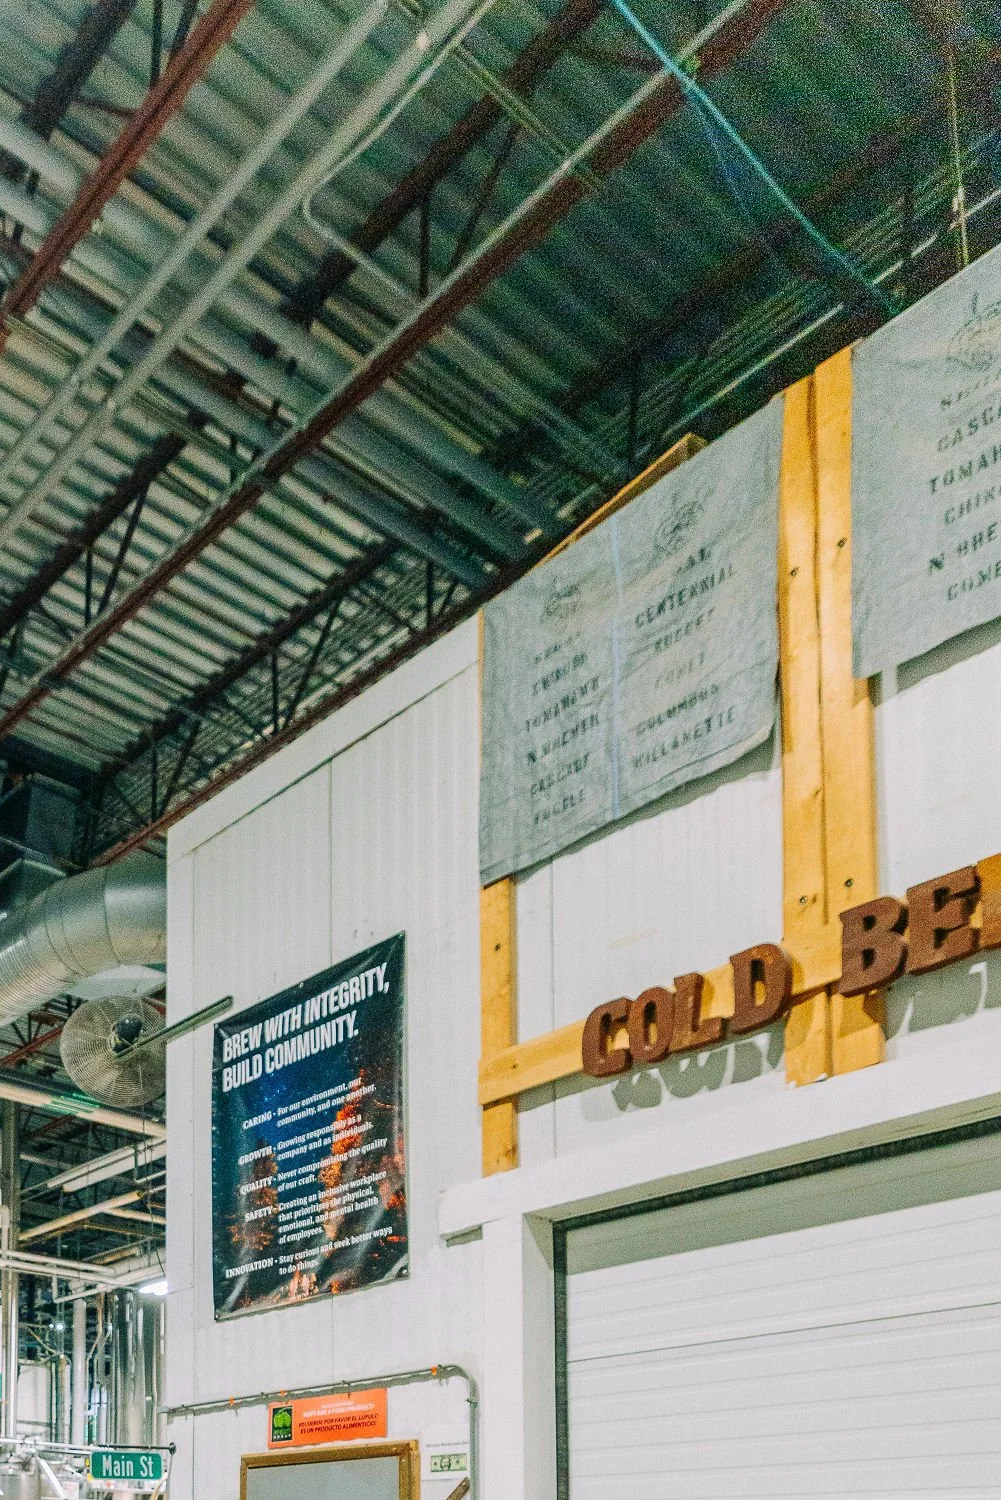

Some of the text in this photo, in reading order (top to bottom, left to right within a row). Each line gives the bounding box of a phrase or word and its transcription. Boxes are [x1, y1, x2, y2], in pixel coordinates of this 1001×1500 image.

[635, 563, 736, 628] CENTENNIAL
[223, 961, 390, 1063] BREW WITH INTEGRITY,
[582, 943, 792, 1078] COLD
[222, 1010, 359, 1093] BUILD COMMUNITY.
[242, 1110, 272, 1130] CARING
[277, 1104, 288, 1116] For
[290, 1101, 300, 1110] our
[301, 1083, 348, 1106] environment,
[276, 1083, 376, 1127] community, and one another.
[238, 1145, 272, 1165] GROWTH
[277, 1134, 306, 1150] Growing
[306, 1118, 346, 1140] responsibly
[277, 1122, 373, 1161] company and as individuals.
[239, 1138, 387, 1196] QUALITY Never compromising the quality
[278, 1175, 317, 1192] of our craft.
[244, 1170, 387, 1222] SAFETY Creating an inclusive workplace
[278, 1212, 293, 1222] that
[330, 1197, 342, 1207] the
[342, 1186, 374, 1202] physical,
[278, 1196, 379, 1233] emotional, and mental health
[225, 1226, 392, 1278] INNOVATION Stay curious and seek better ways
[279, 1226, 323, 1244] of employees.
[279, 1266, 286, 1275] to
[287, 1264, 296, 1273] do
[315, 1424, 342, 1432] PRODUCTO
[102, 1454, 154, 1478] Main St
